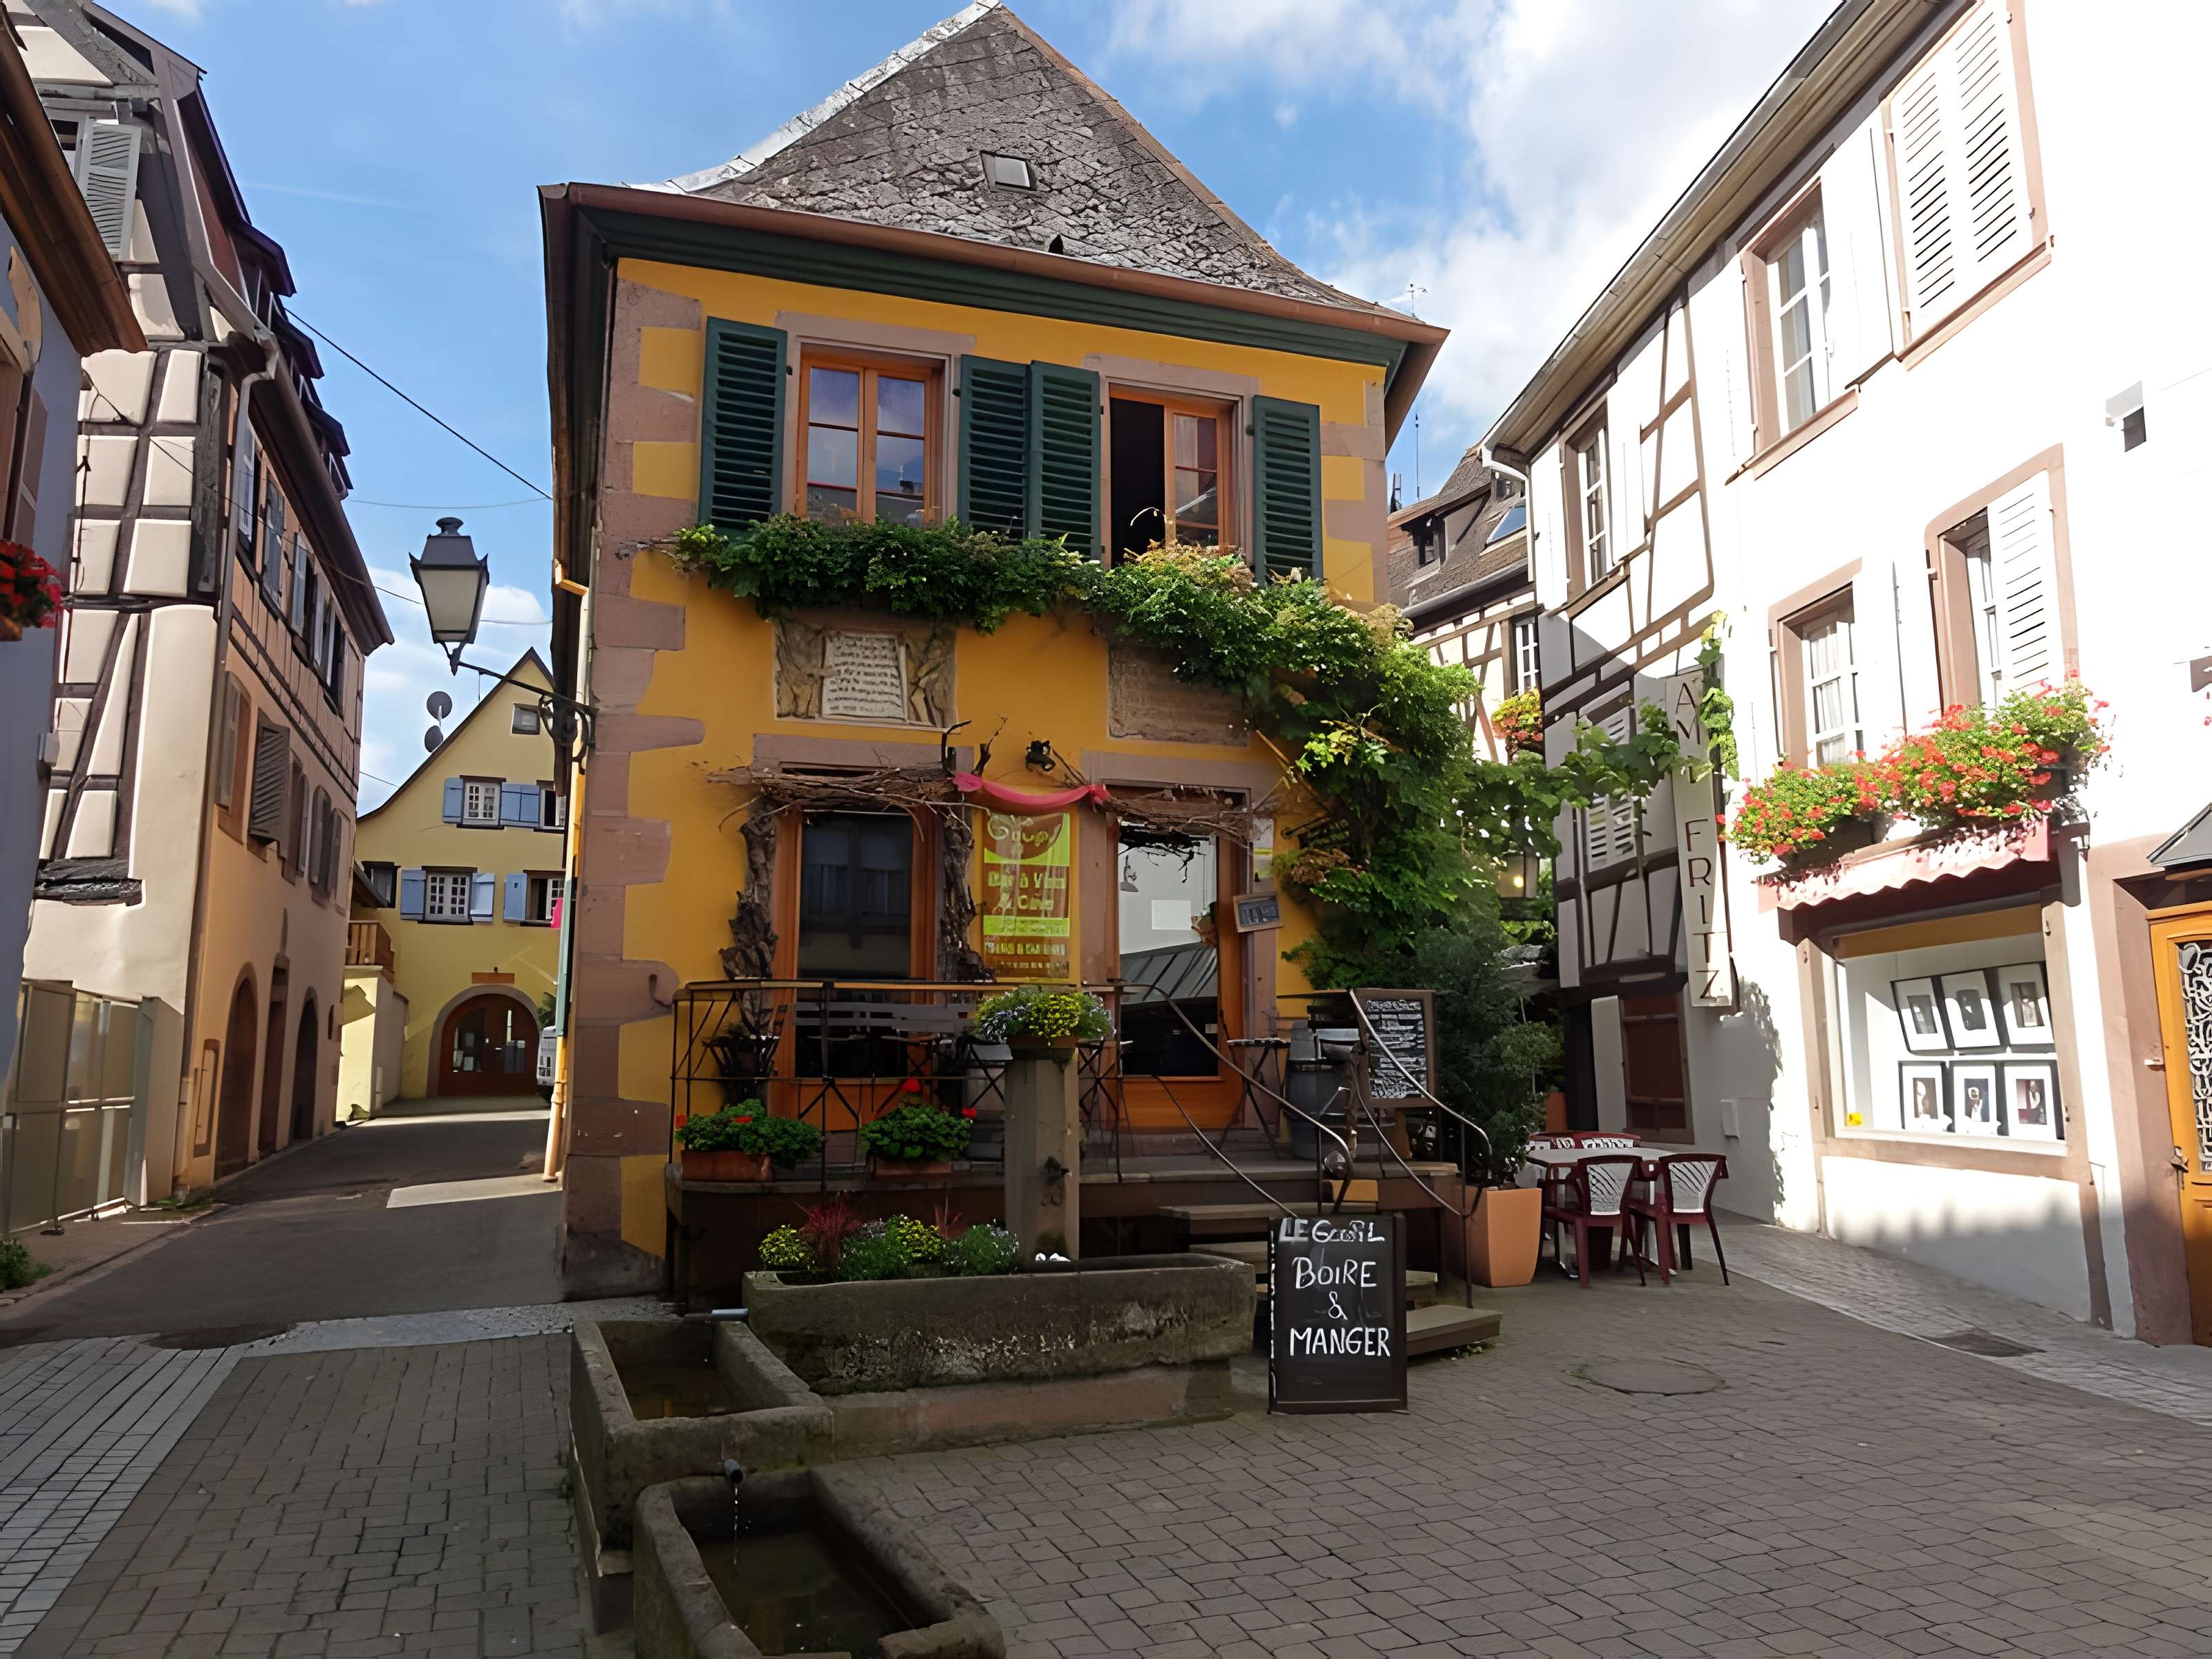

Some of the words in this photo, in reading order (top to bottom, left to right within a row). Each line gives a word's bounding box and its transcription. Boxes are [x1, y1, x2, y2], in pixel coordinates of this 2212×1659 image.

[1685, 818, 1727, 1000] FRITZ
[1279, 1217, 1309, 1242] LE
[1292, 1257, 1377, 1289] BOIRE
[1328, 1291, 1348, 1320] &
[1290, 1327, 1391, 1357] MANGER
